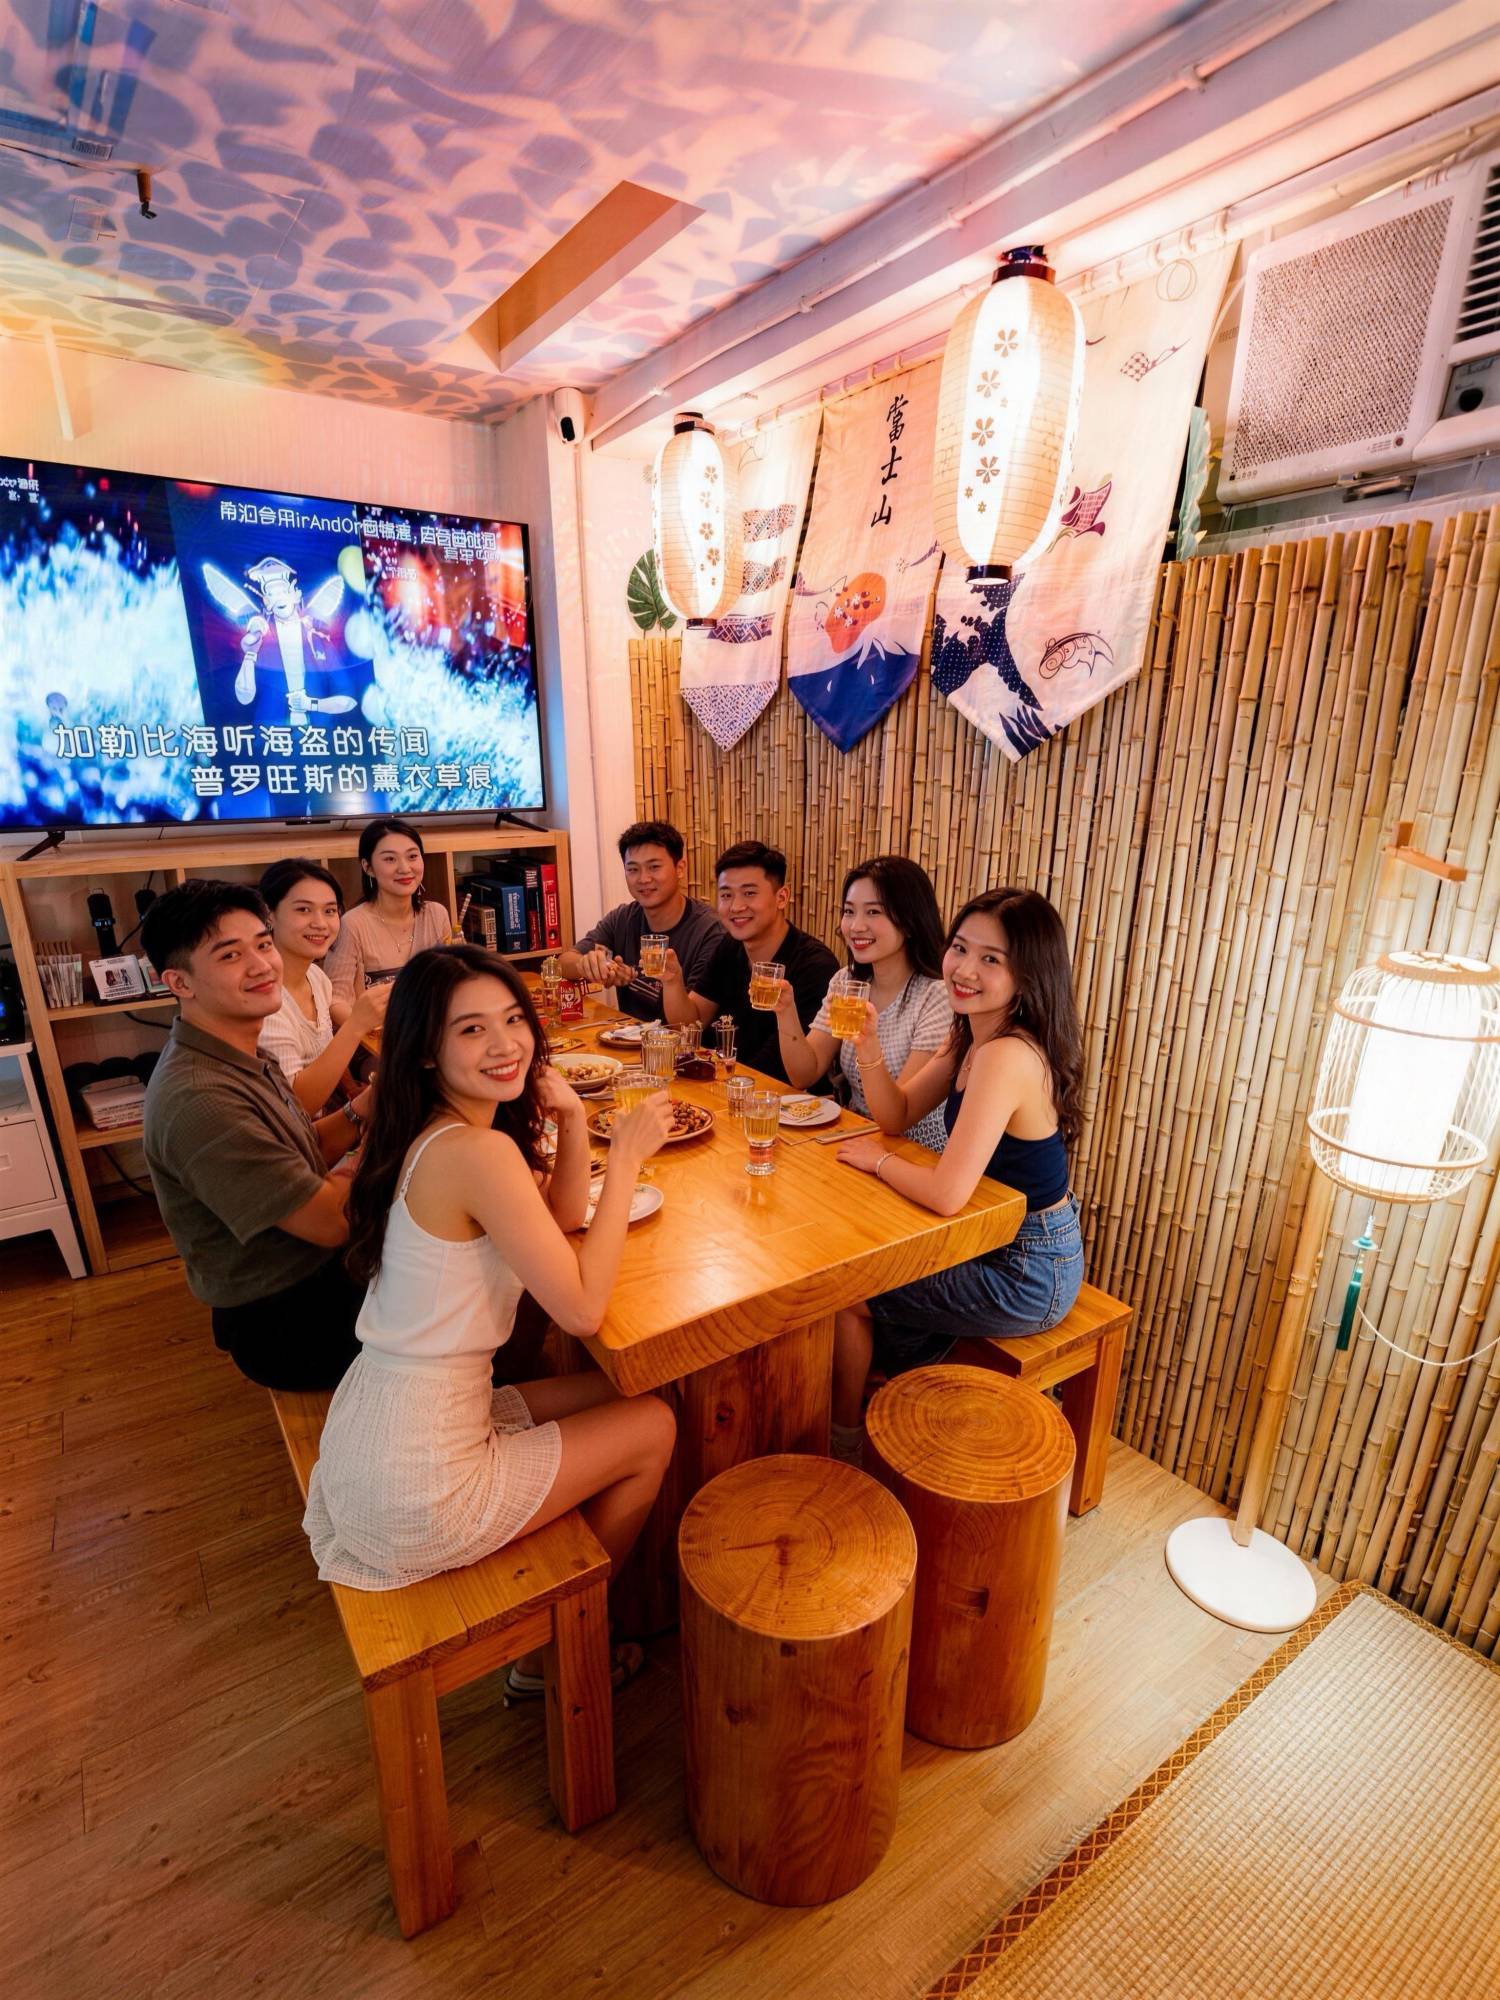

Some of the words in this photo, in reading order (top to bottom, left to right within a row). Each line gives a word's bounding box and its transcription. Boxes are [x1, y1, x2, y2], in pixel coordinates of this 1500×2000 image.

[54, 723, 429, 758] 加勒比海听海盗的传闻
[191, 763, 493, 797] 普罗旺斯的薰衣草痕
